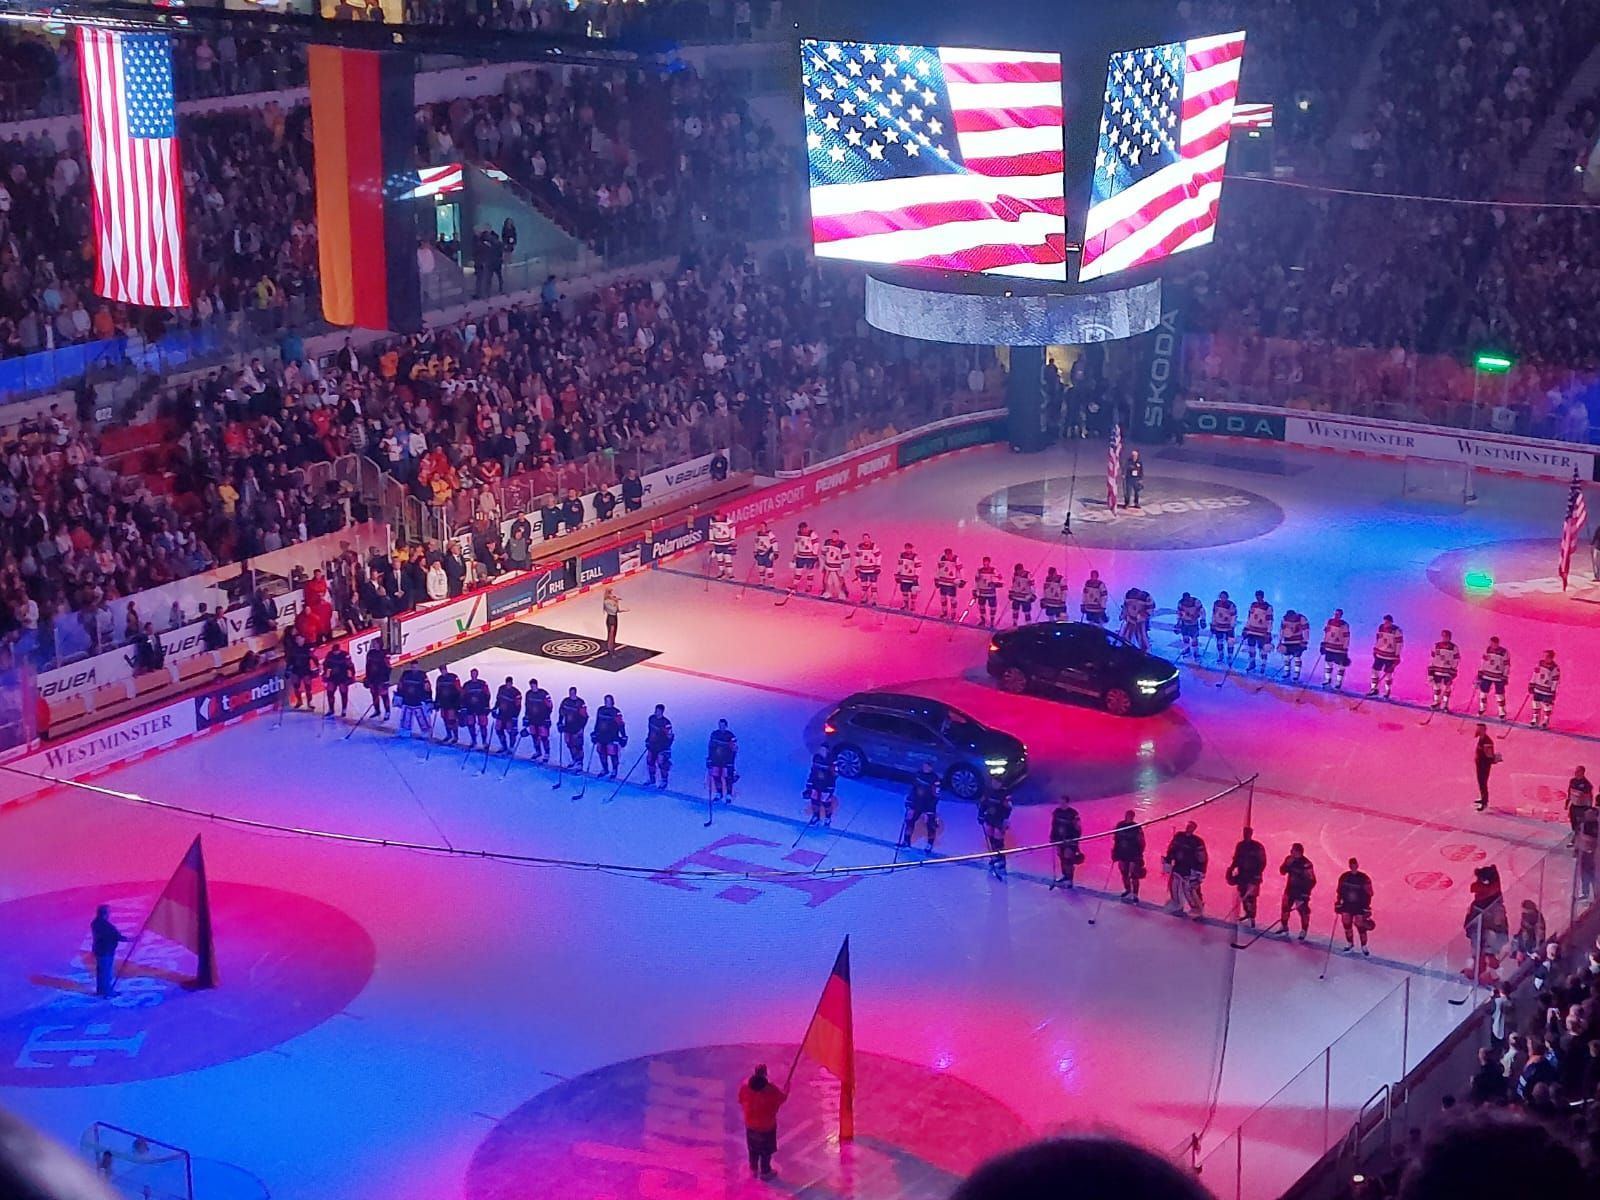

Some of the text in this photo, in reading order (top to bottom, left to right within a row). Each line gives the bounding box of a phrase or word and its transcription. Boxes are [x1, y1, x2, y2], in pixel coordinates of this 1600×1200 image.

[1197, 414, 1274, 436] ODA
[1307, 420, 1415, 448] WESTMINSTER
[1458, 439, 1571, 468] WESTMINSTER
[775, 485, 806, 508] SPORT
[652, 529, 703, 559] Polarweiss
[37, 667, 96, 697] AUER
[44, 713, 173, 769] WESTMINSTER
